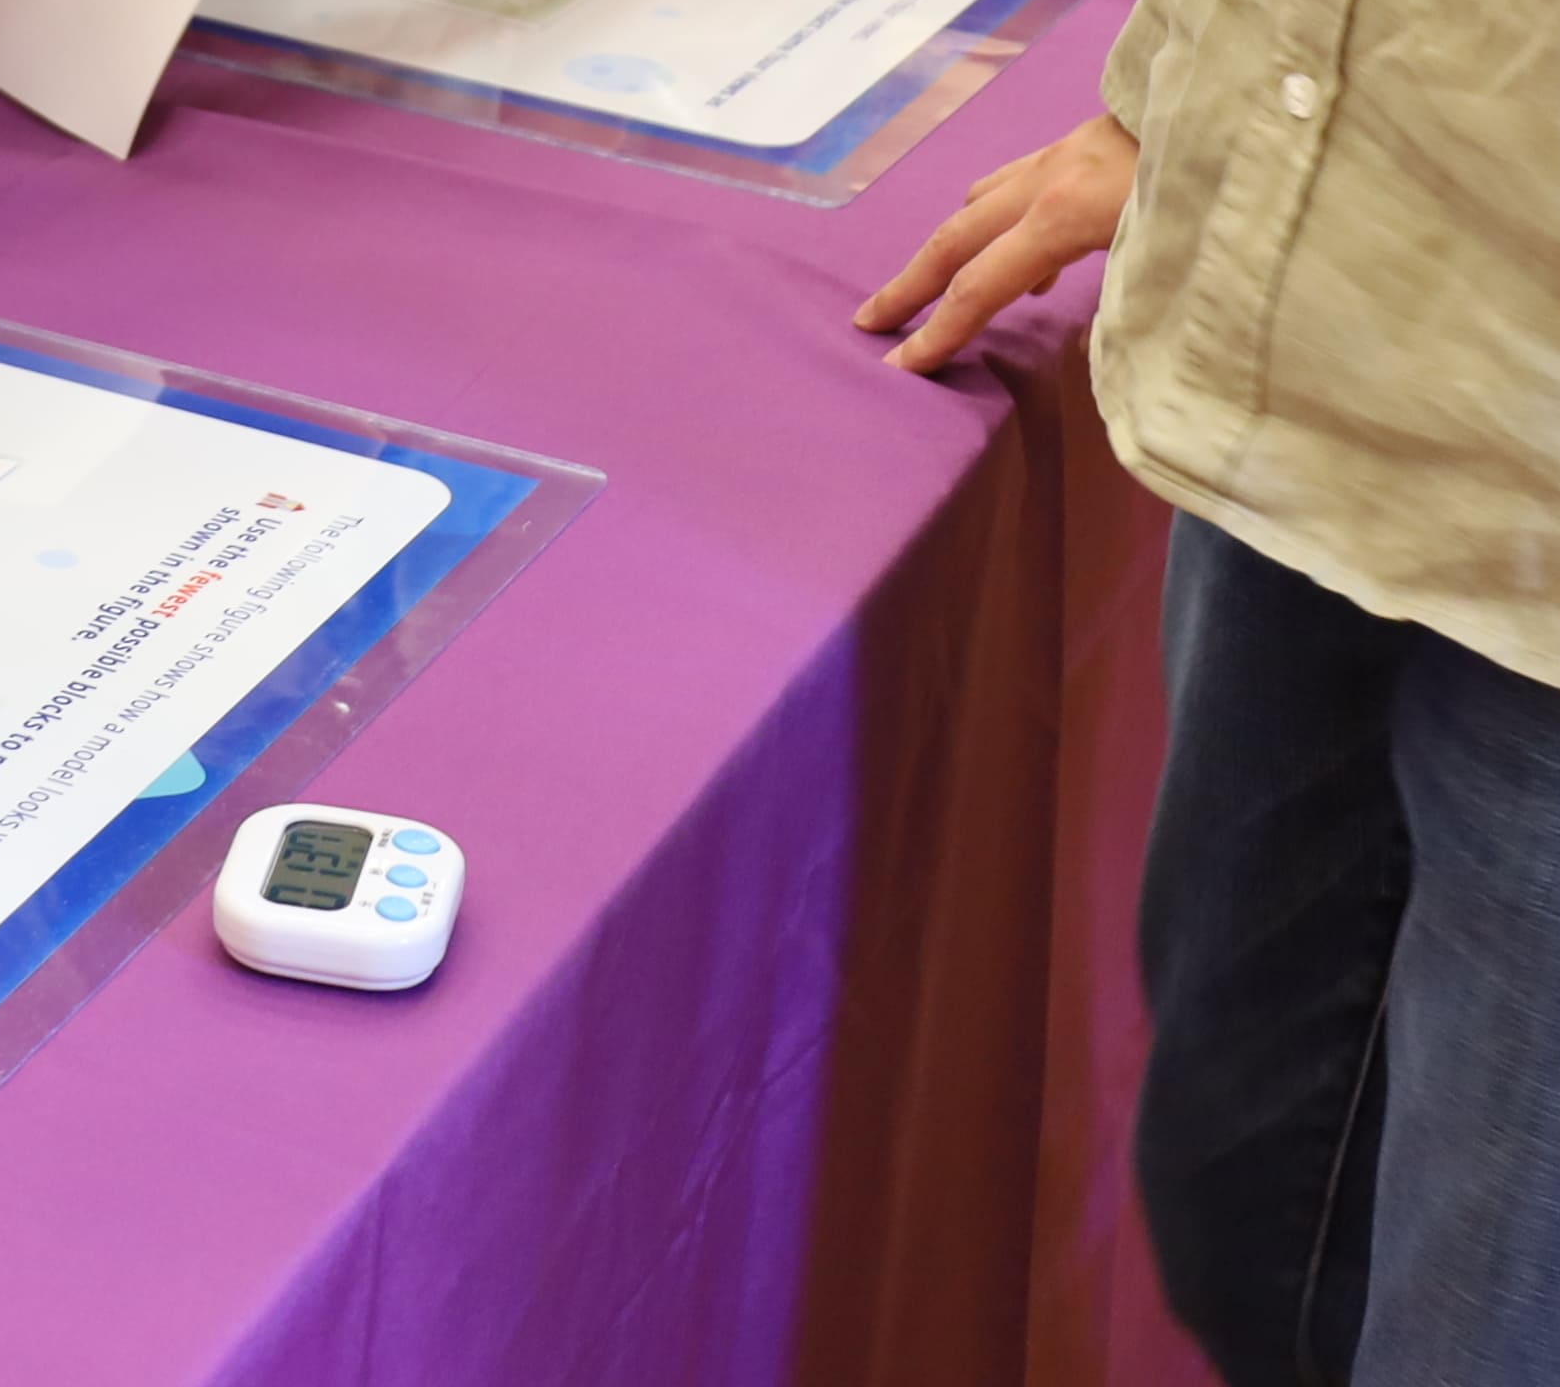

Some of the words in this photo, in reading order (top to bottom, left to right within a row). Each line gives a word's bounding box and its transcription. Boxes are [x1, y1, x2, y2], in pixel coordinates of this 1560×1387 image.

[179, 506, 240, 551] shown
[237, 517, 281, 542] Use
[320, 515, 364, 537] The
[160, 552, 194, 567] in
[208, 544, 247, 568] the
[246, 541, 334, 600] following
[129, 569, 170, 594] the
[151, 570, 222, 618] fewest
[71, 595, 143, 640] figure.
[204, 601, 267, 642] figure
[81, 617, 160, 678] possible
[153, 643, 213, 688] shows
[22, 681, 96, 730] blocks
[118, 690, 169, 722] how
[0, 733, 33, 750] to
[102, 722, 124, 733] a
[48, 735, 111, 786] model
